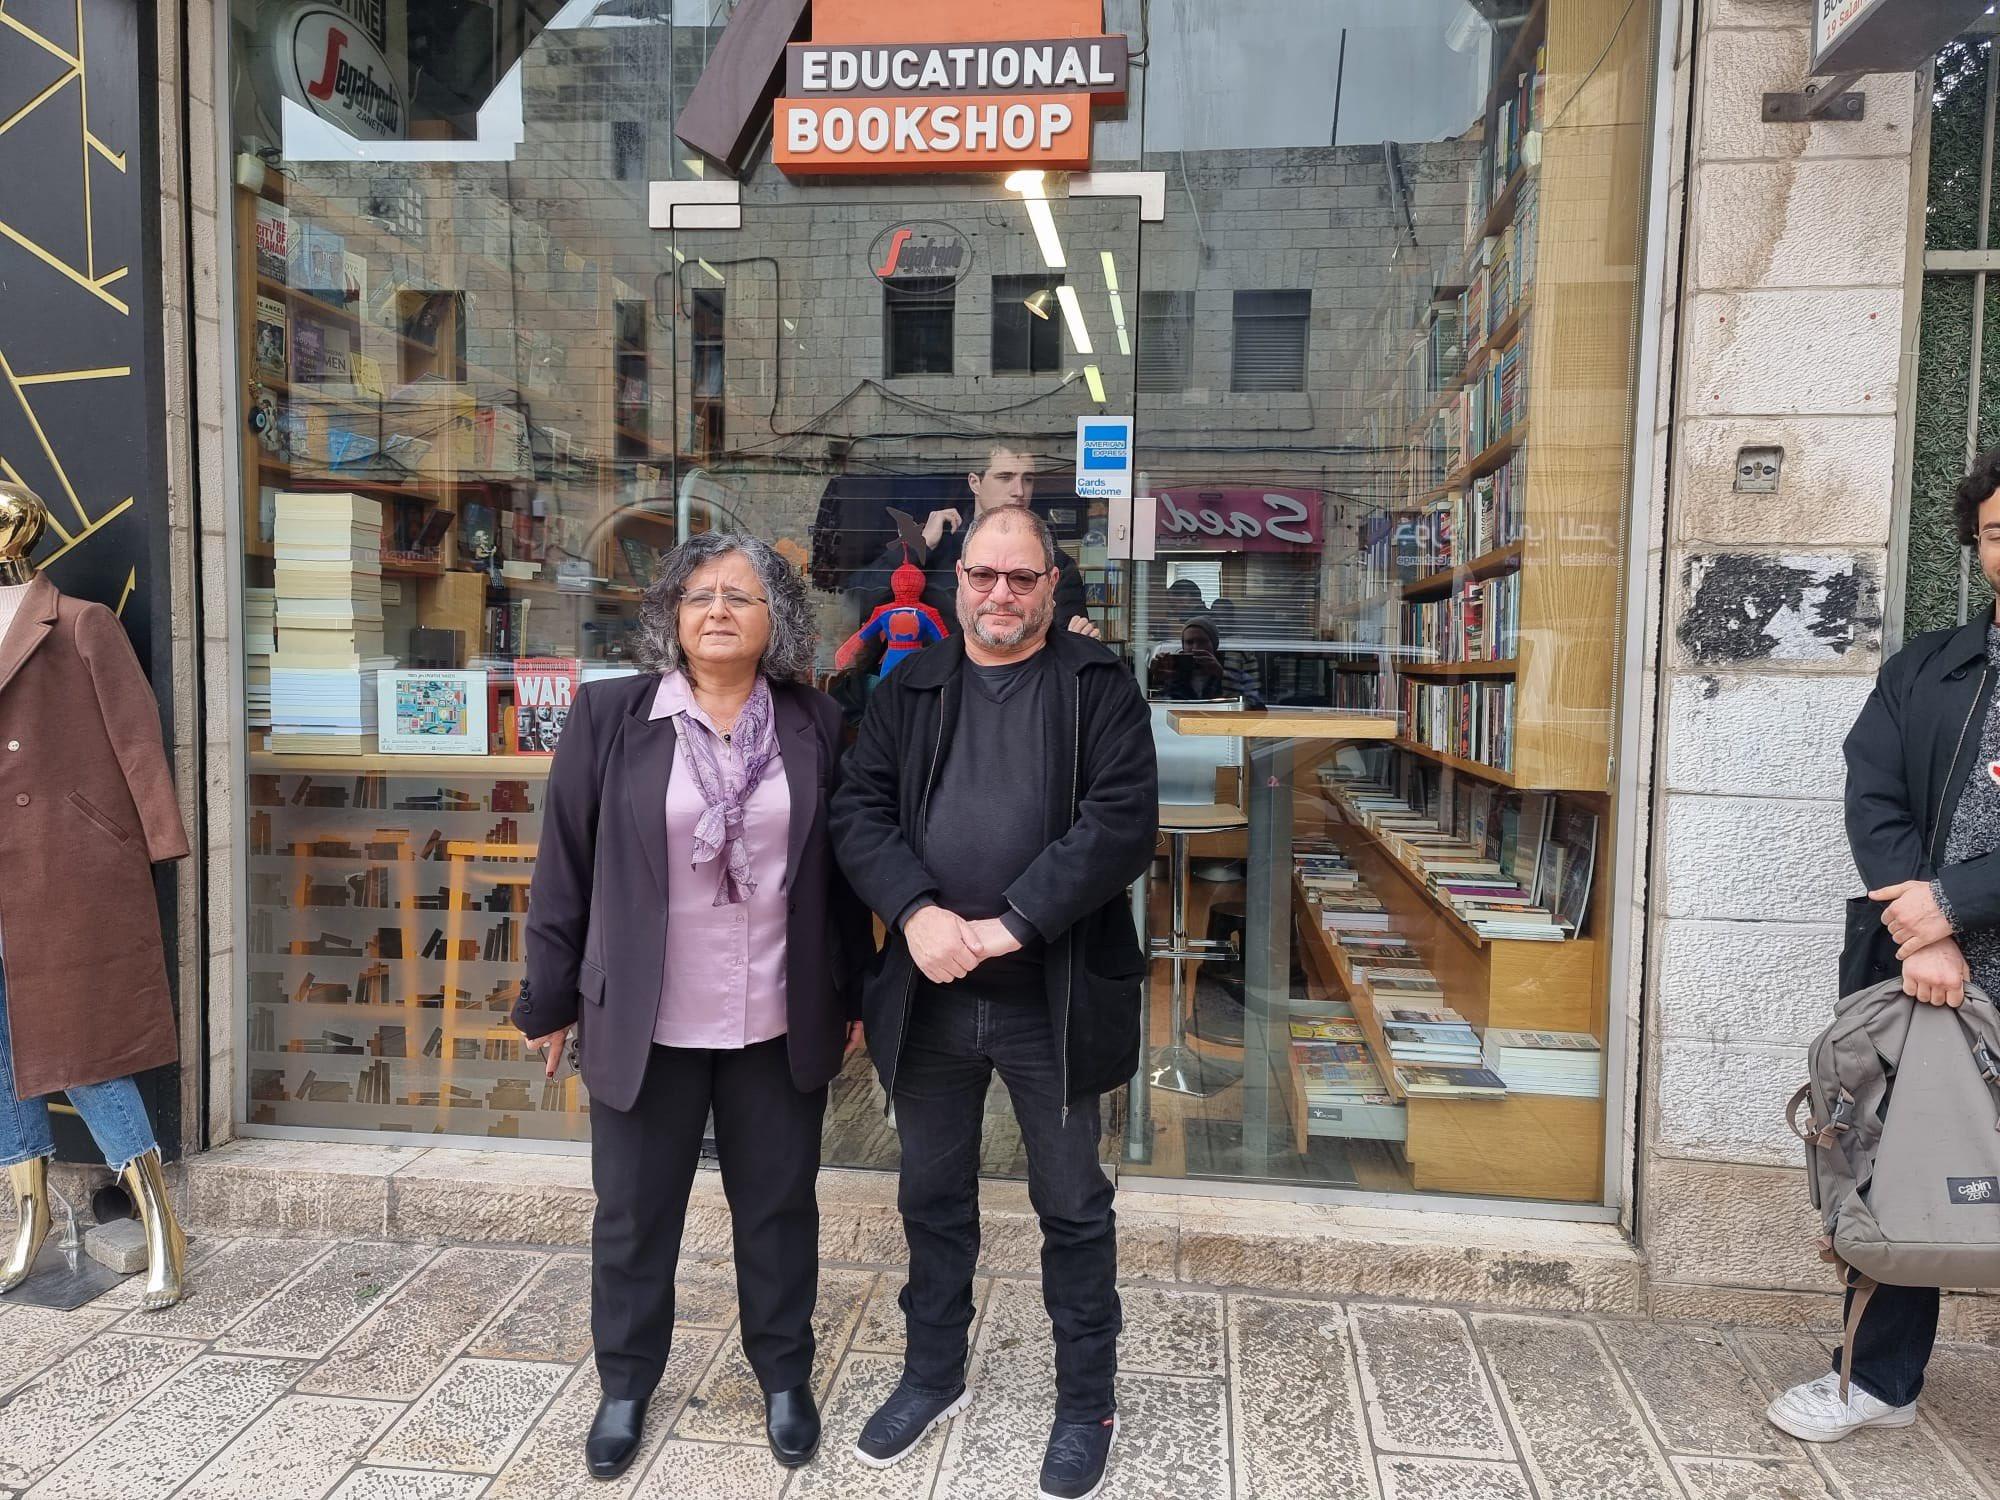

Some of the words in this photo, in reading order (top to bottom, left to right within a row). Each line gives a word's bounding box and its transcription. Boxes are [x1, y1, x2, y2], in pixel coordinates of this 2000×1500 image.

[1823, 0, 1843, 20] BO
[1826, 19, 1837, 40] 19
[802, 45, 1116, 91] EDUCATIONAL
[307, 27, 399, 134] Segafredo
[356, 109, 386, 136] ZANETTI
[787, 104, 1072, 152] BOOKSHOP
[256, 222, 275, 241] CITY
[276, 231, 287, 245] OF
[271, 217, 286, 234] THE
[256, 234, 287, 257] BRAHAM
[265, 302, 284, 315] ANGEL
[1077, 478, 1106, 487] Cards
[1077, 487, 1122, 496] Welcome
[516, 676, 571, 706] WAR
[1958, 1180, 1992, 1195] cabin
[1967, 1190, 1990, 1201] zero
